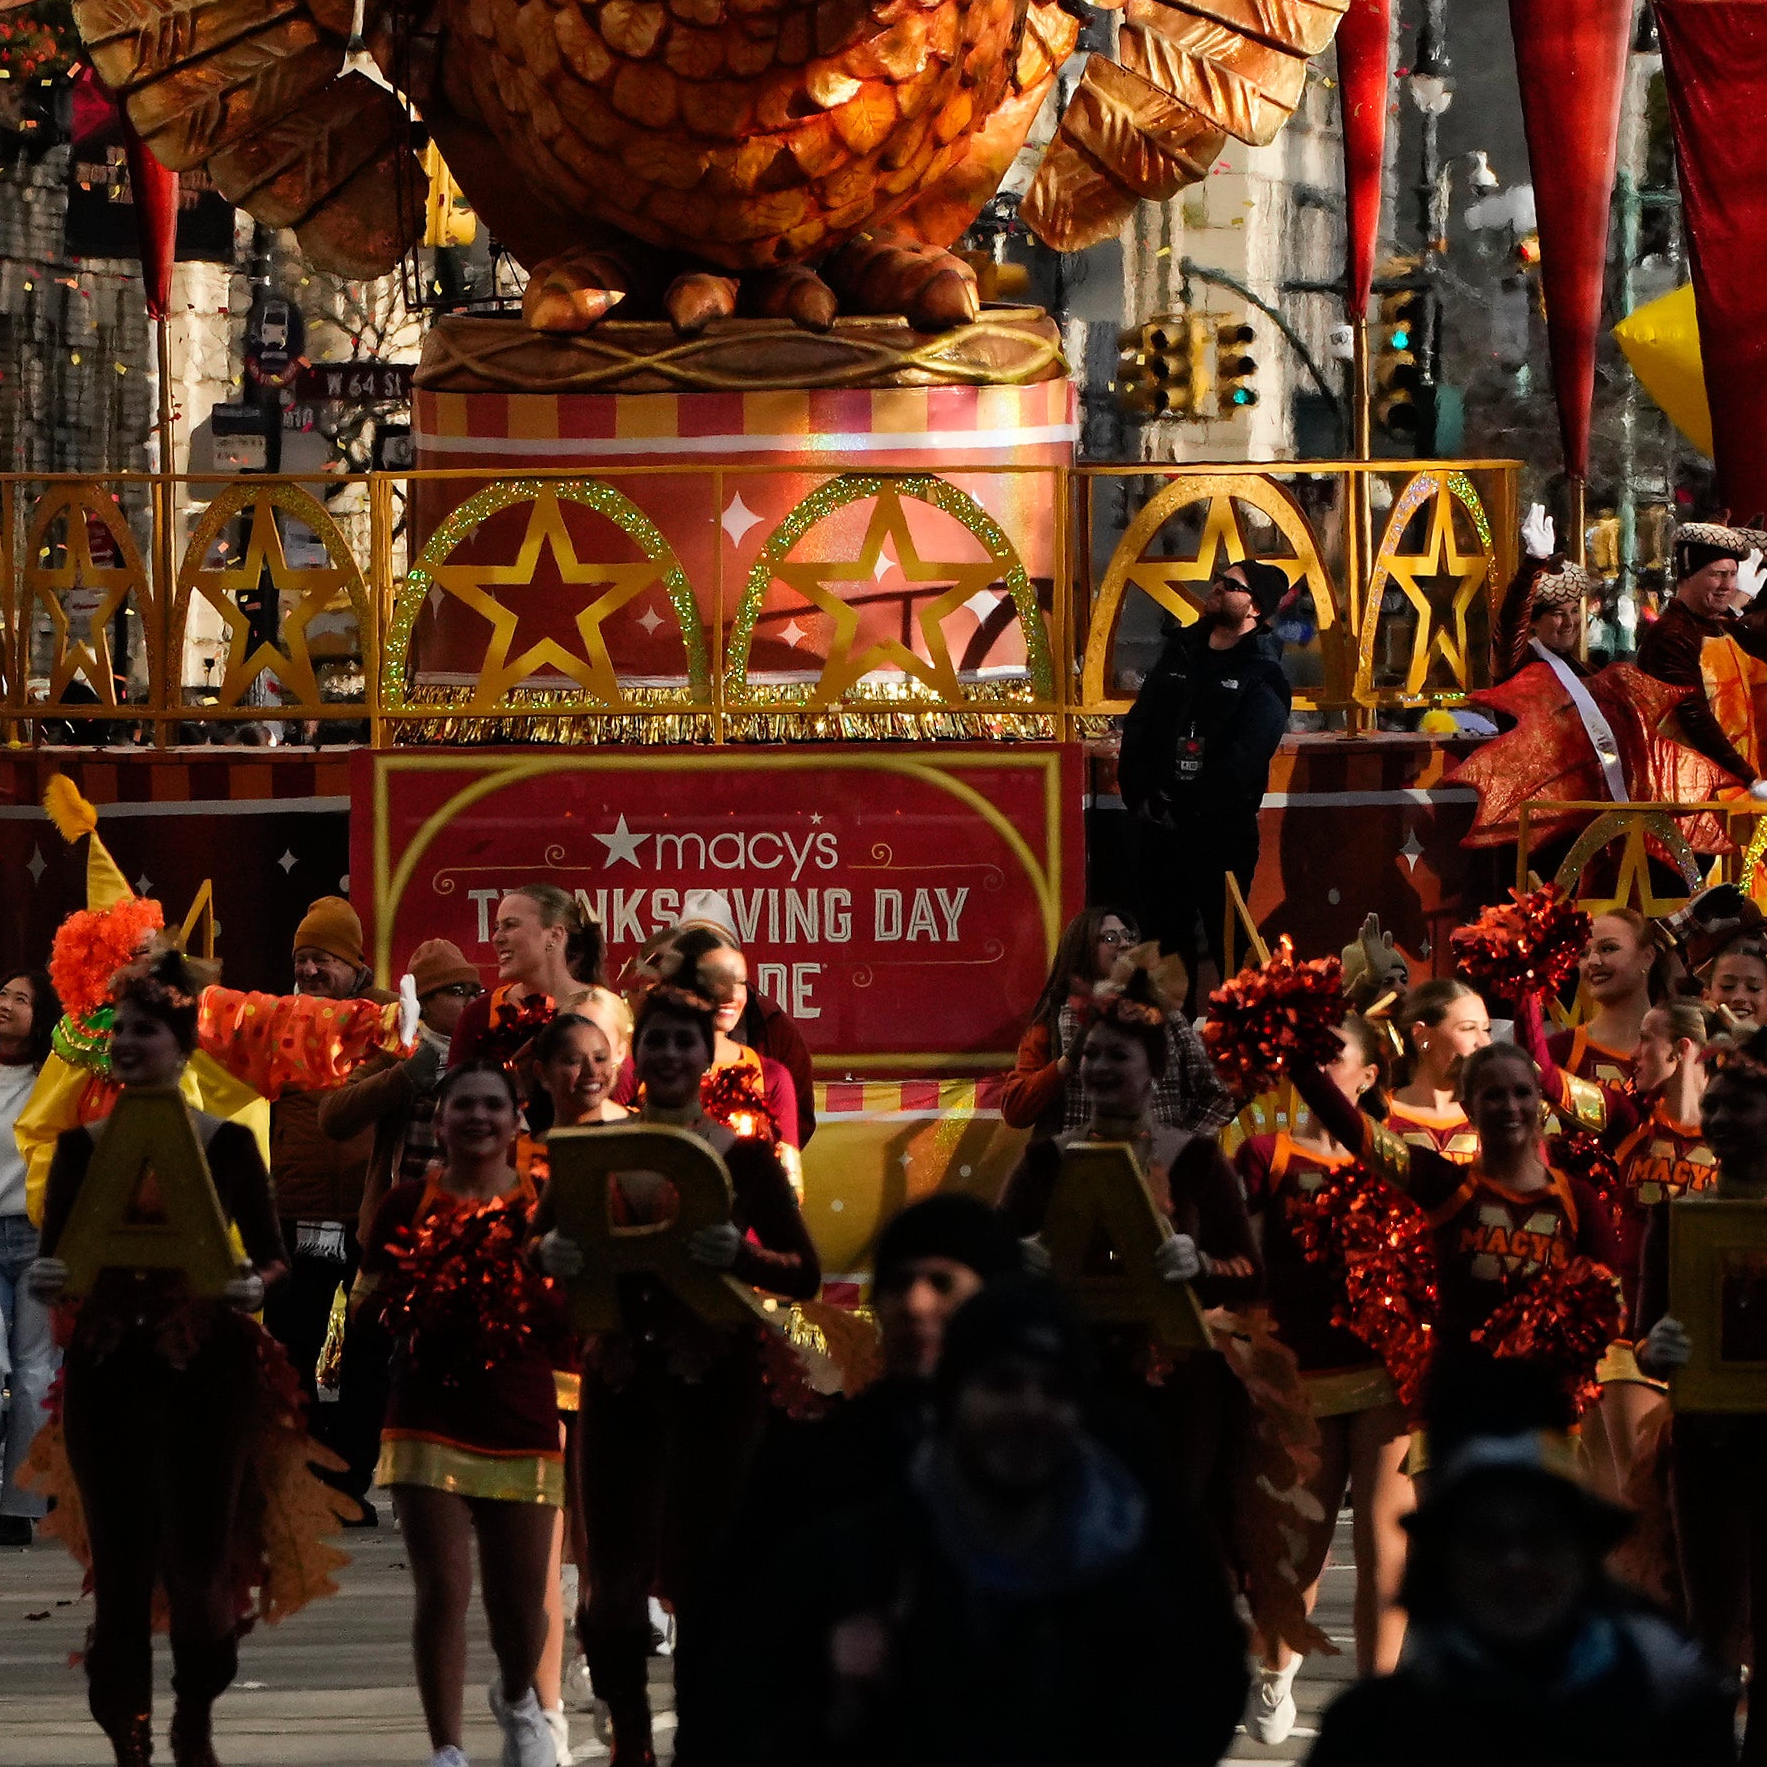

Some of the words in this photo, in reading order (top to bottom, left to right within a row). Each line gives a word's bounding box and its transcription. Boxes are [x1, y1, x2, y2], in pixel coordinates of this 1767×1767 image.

[327, 372, 343, 396] W
[349, 371, 375, 397] 64
[468, 887, 851, 944] TNKSVING
[875, 887, 970, 942] DAY
[52, 1086, 242, 1298] A
[547, 1122, 781, 1335] R
